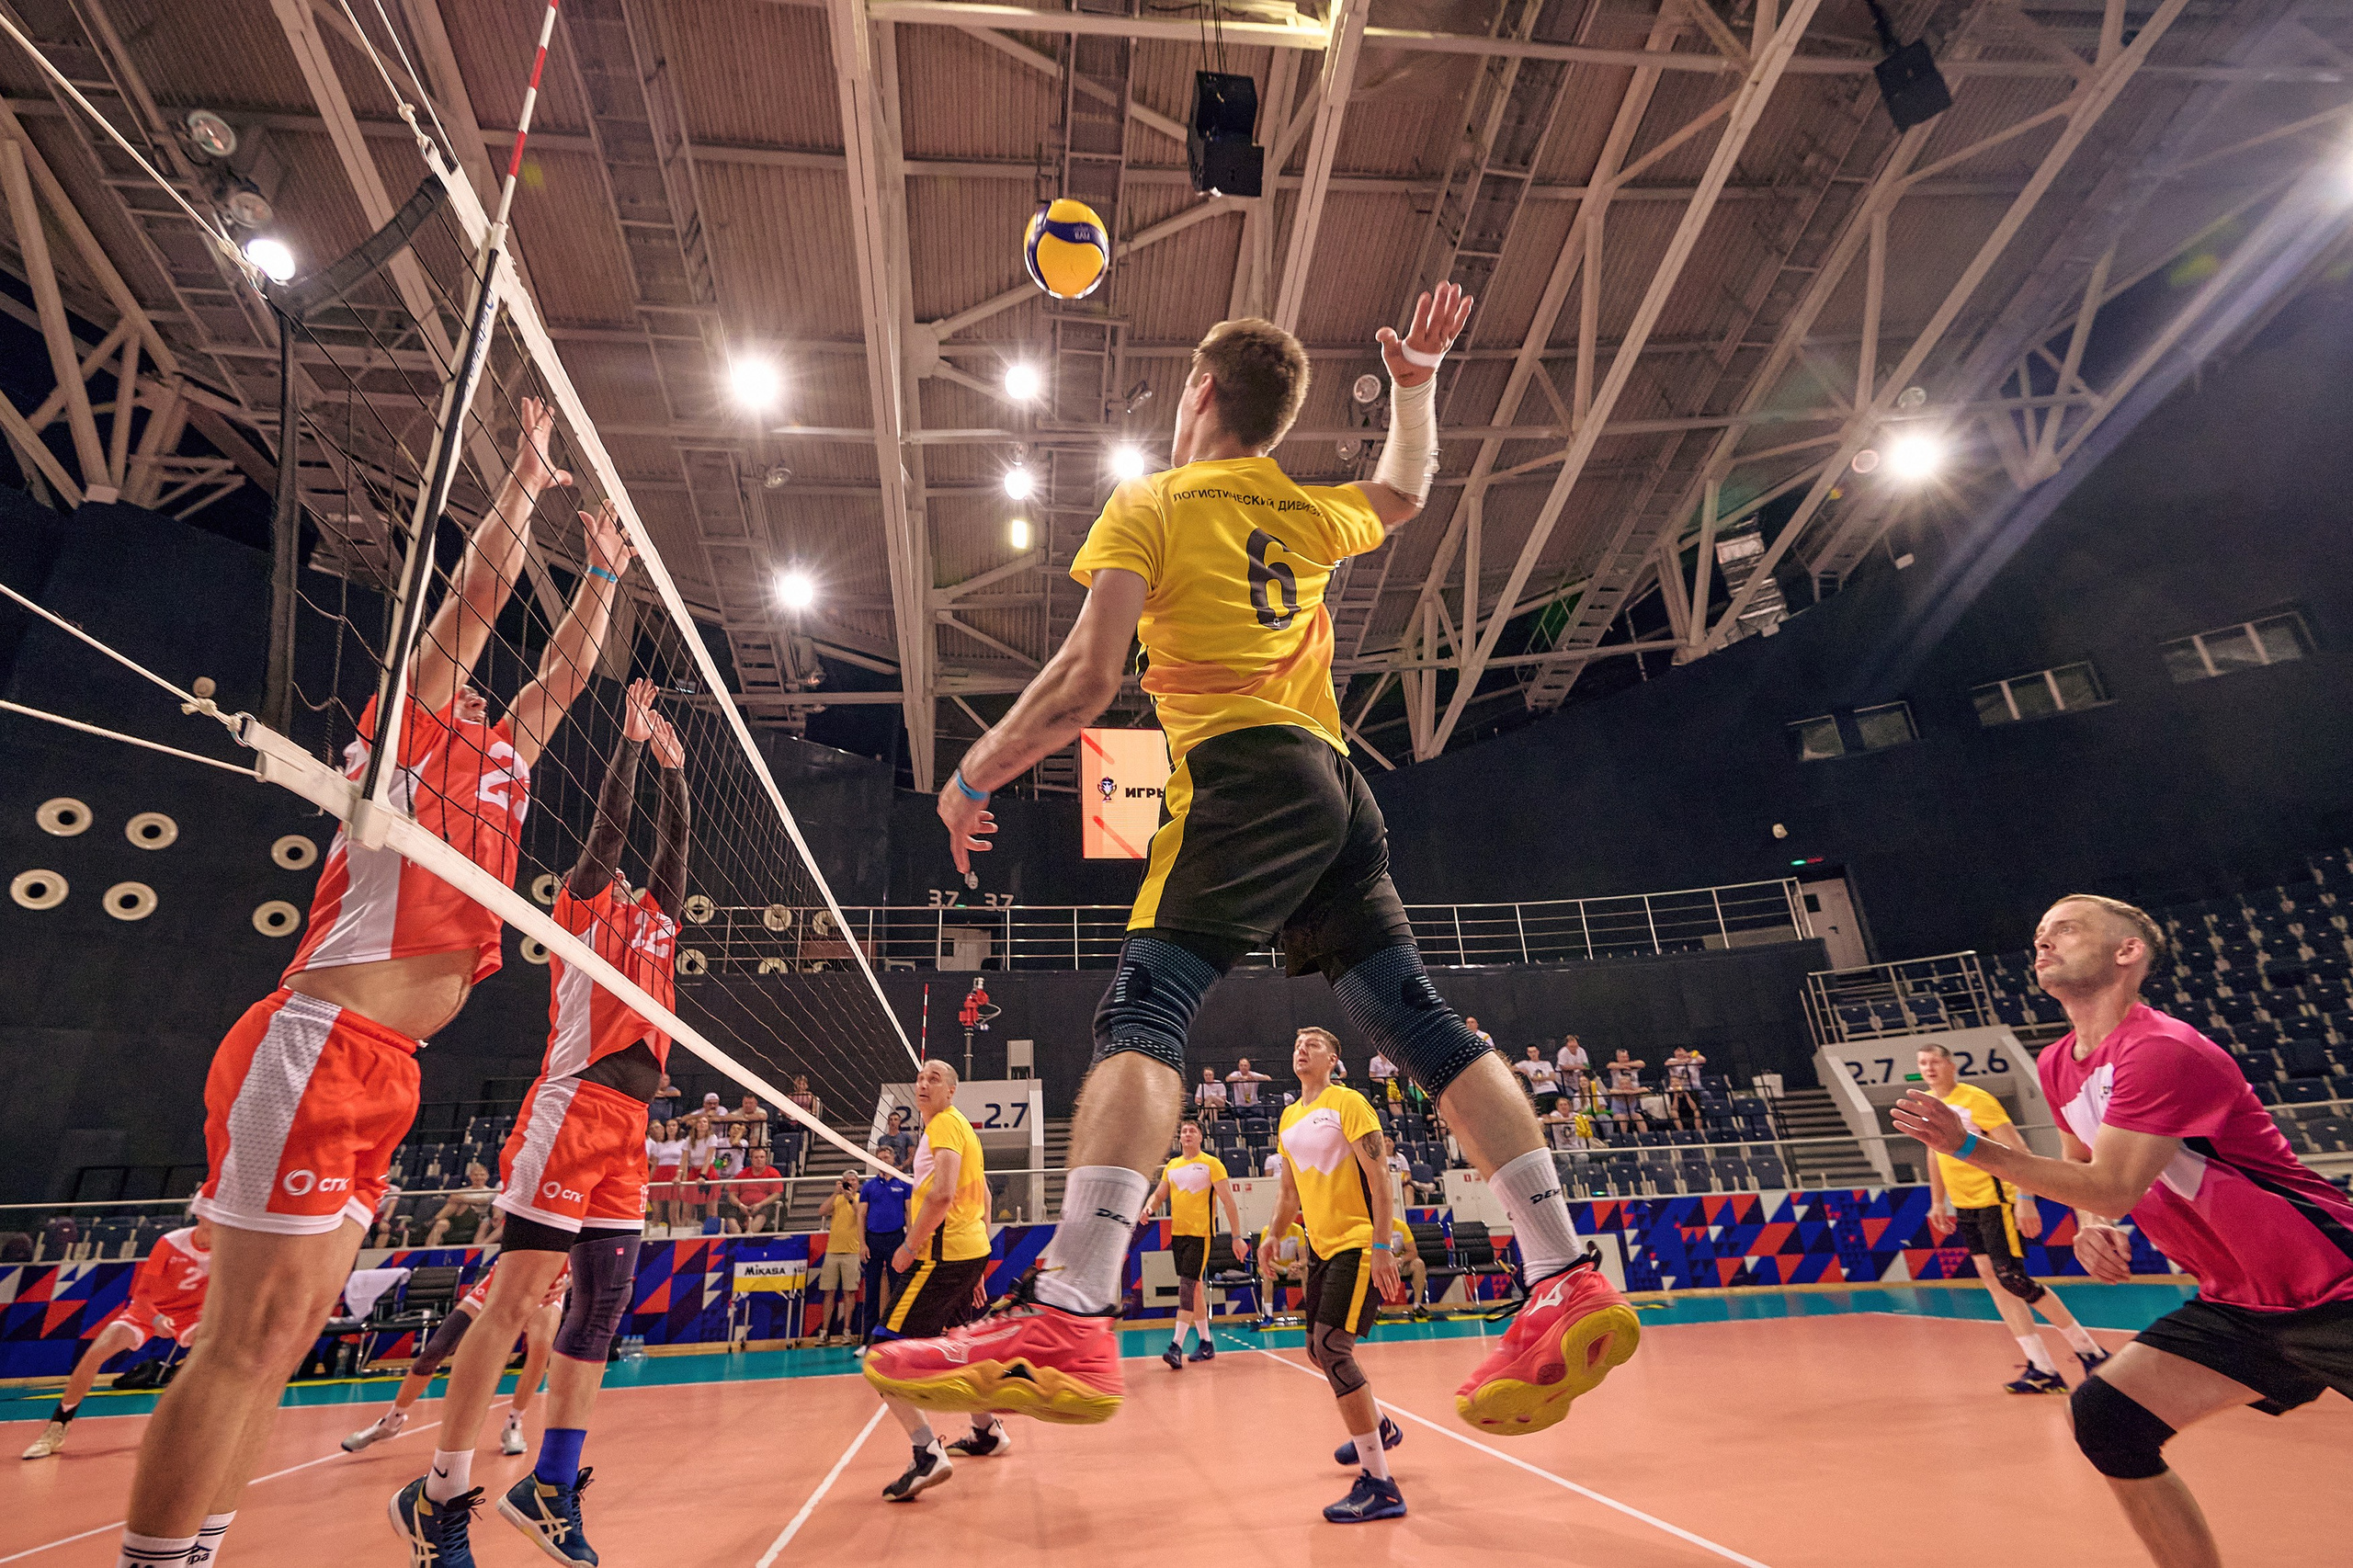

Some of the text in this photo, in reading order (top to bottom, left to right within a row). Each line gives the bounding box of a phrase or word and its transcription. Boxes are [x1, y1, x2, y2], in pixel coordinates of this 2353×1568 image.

[1173, 489, 1274, 508] ЛОГИСТИЧЕСКИЙ
[1246, 528, 1302, 631] 6
[631, 909, 676, 959] 12
[1845, 1058, 1894, 1085] 2.7
[1953, 1048, 2010, 1076] 2.6
[984, 1103, 1029, 1129] 2.7
[177, 1267, 203, 1290] 2
